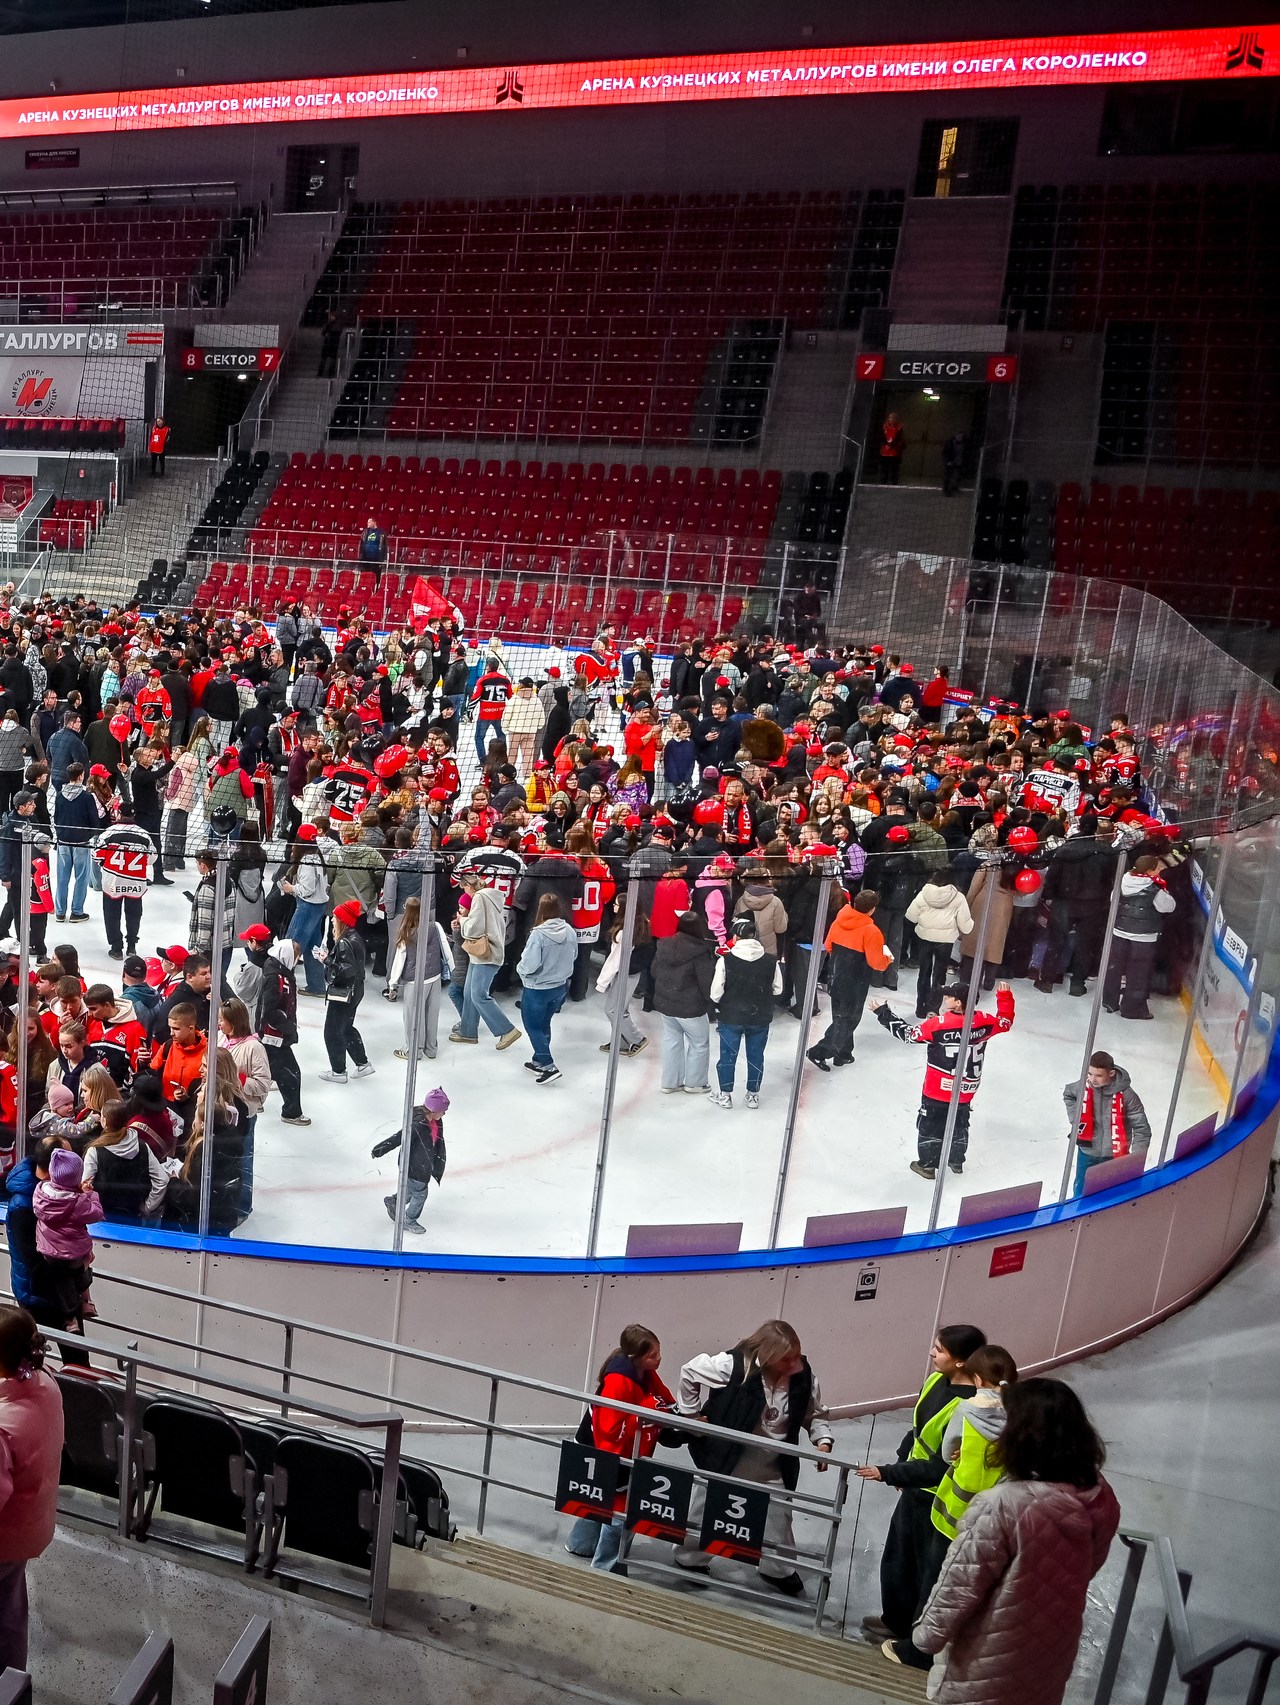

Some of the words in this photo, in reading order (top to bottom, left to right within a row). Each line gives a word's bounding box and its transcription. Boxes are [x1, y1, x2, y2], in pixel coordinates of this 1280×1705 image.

[580, 77, 635, 91] АРЕНА
[639, 71, 741, 88] КУЗНЕЦКИХ
[746, 65, 877, 82] МЕТАЛЛУРГОВ
[882, 61, 947, 77] ИМЕНИ
[952, 57, 1016, 74] ОЛЕГА
[1021, 50, 1147, 70] КОРОЛЕНКО
[18, 111, 59, 124] АРЕНА
[62, 105, 138, 121] КУЗНЕЦКИХ
[142, 99, 239, 116] МЕТАЛЛУРГОВ
[243, 95, 290, 109] ИМЕНИ
[294, 92, 342, 107] ОЛЕГА
[346, 87, 438, 104] КОРОЛЕНКО
[187, 354, 196, 366] 8
[204, 355, 257, 366] СЕКТОР
[264, 355, 274, 367] 7
[864, 361, 876, 375] 7
[900, 362, 971, 375] СЕКТОР
[994, 363, 1007, 377] 6
[12, 369, 44, 398] МЕТАЛЛУРГ
[485, 685, 507, 701] 75
[334, 781, 365, 810] 25
[110, 849, 146, 871] 42
[115, 884, 142, 894] ЕВРАЗ
[576, 930, 597, 938] ВРАЗ
[1229, 939, 1245, 960] ЕВРАЗ
[943, 1028, 987, 1040] СТАИКОВ
[585, 1457, 595, 1481] 1
[569, 1480, 604, 1501] РЯД
[650, 1475, 672, 1500] 2
[640, 1500, 675, 1521] РЯД
[725, 1494, 746, 1519] 3
[714, 1519, 750, 1541] РЯД
